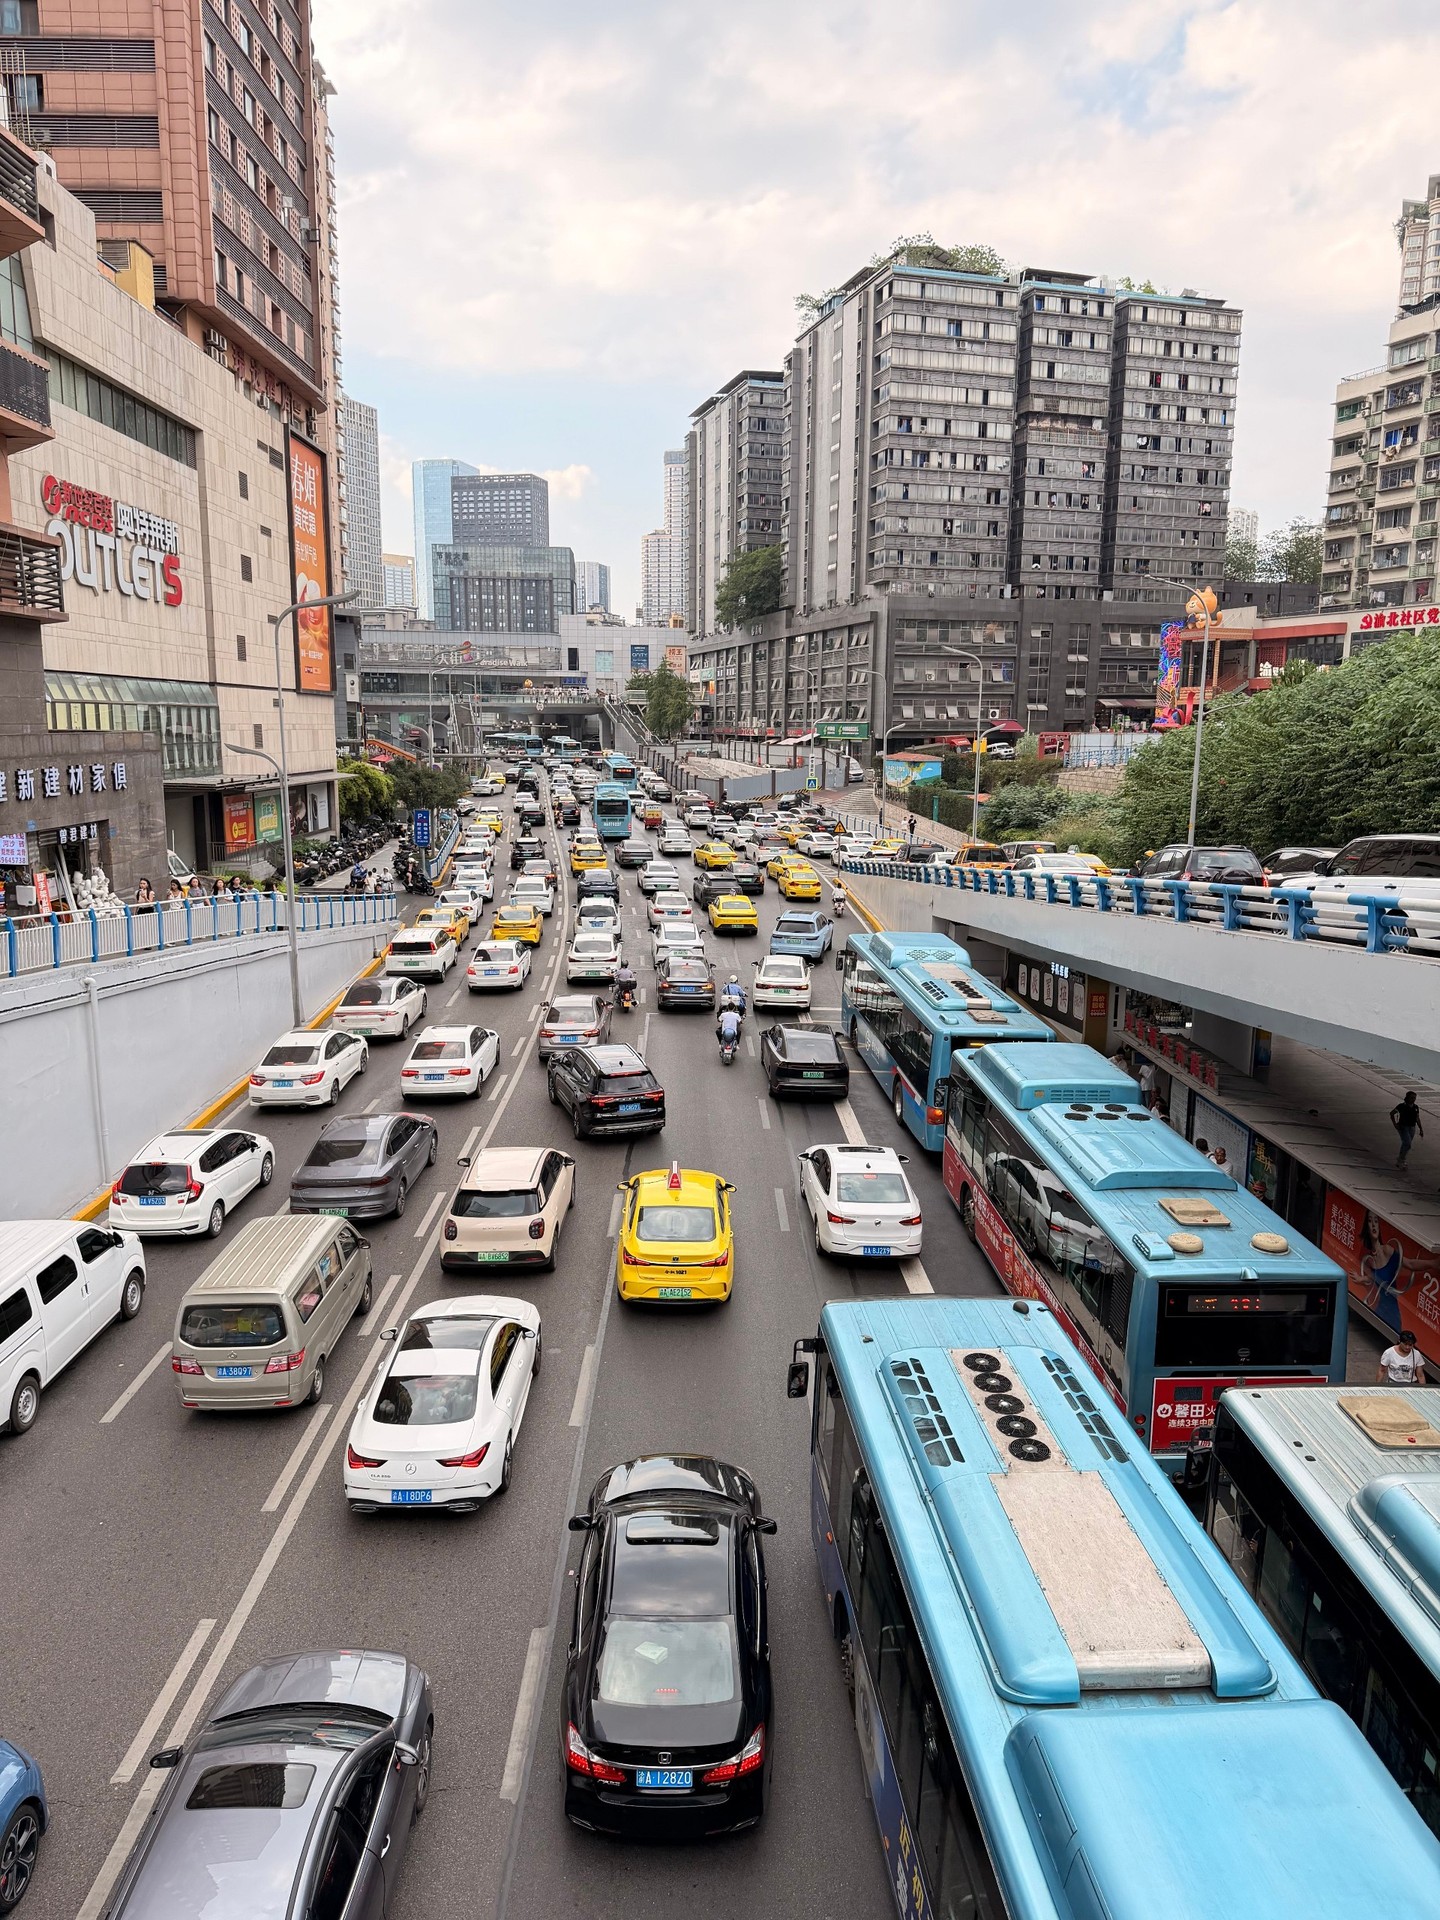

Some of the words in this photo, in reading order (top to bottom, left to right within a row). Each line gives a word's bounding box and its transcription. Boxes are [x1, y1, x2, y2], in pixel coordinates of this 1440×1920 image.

[291, 454, 317, 508] 春娟
[115, 501, 179, 555] 奥特莱斯
[45, 519, 182, 607] OUTLETS
[475, 658, 507, 667] aradise
[1174, 1403, 1205, 1418] 馨田
